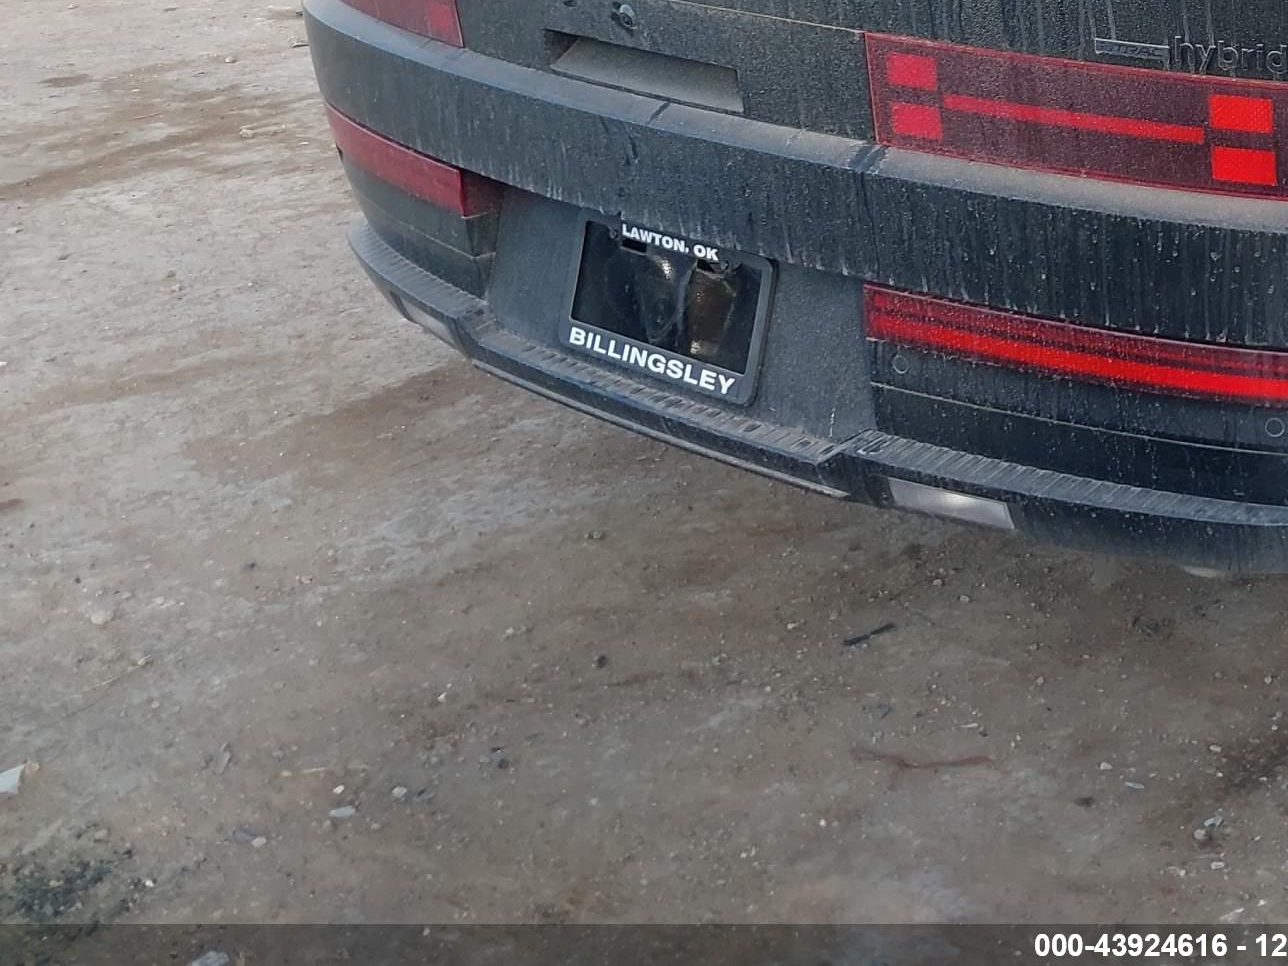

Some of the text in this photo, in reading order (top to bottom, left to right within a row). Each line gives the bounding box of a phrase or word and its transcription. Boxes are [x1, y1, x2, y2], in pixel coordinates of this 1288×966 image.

[1174, 35, 1288, 75] hybrid
[621, 223, 719, 261] LAWTON, OK
[568, 326, 735, 395] BILLINGSLEY
